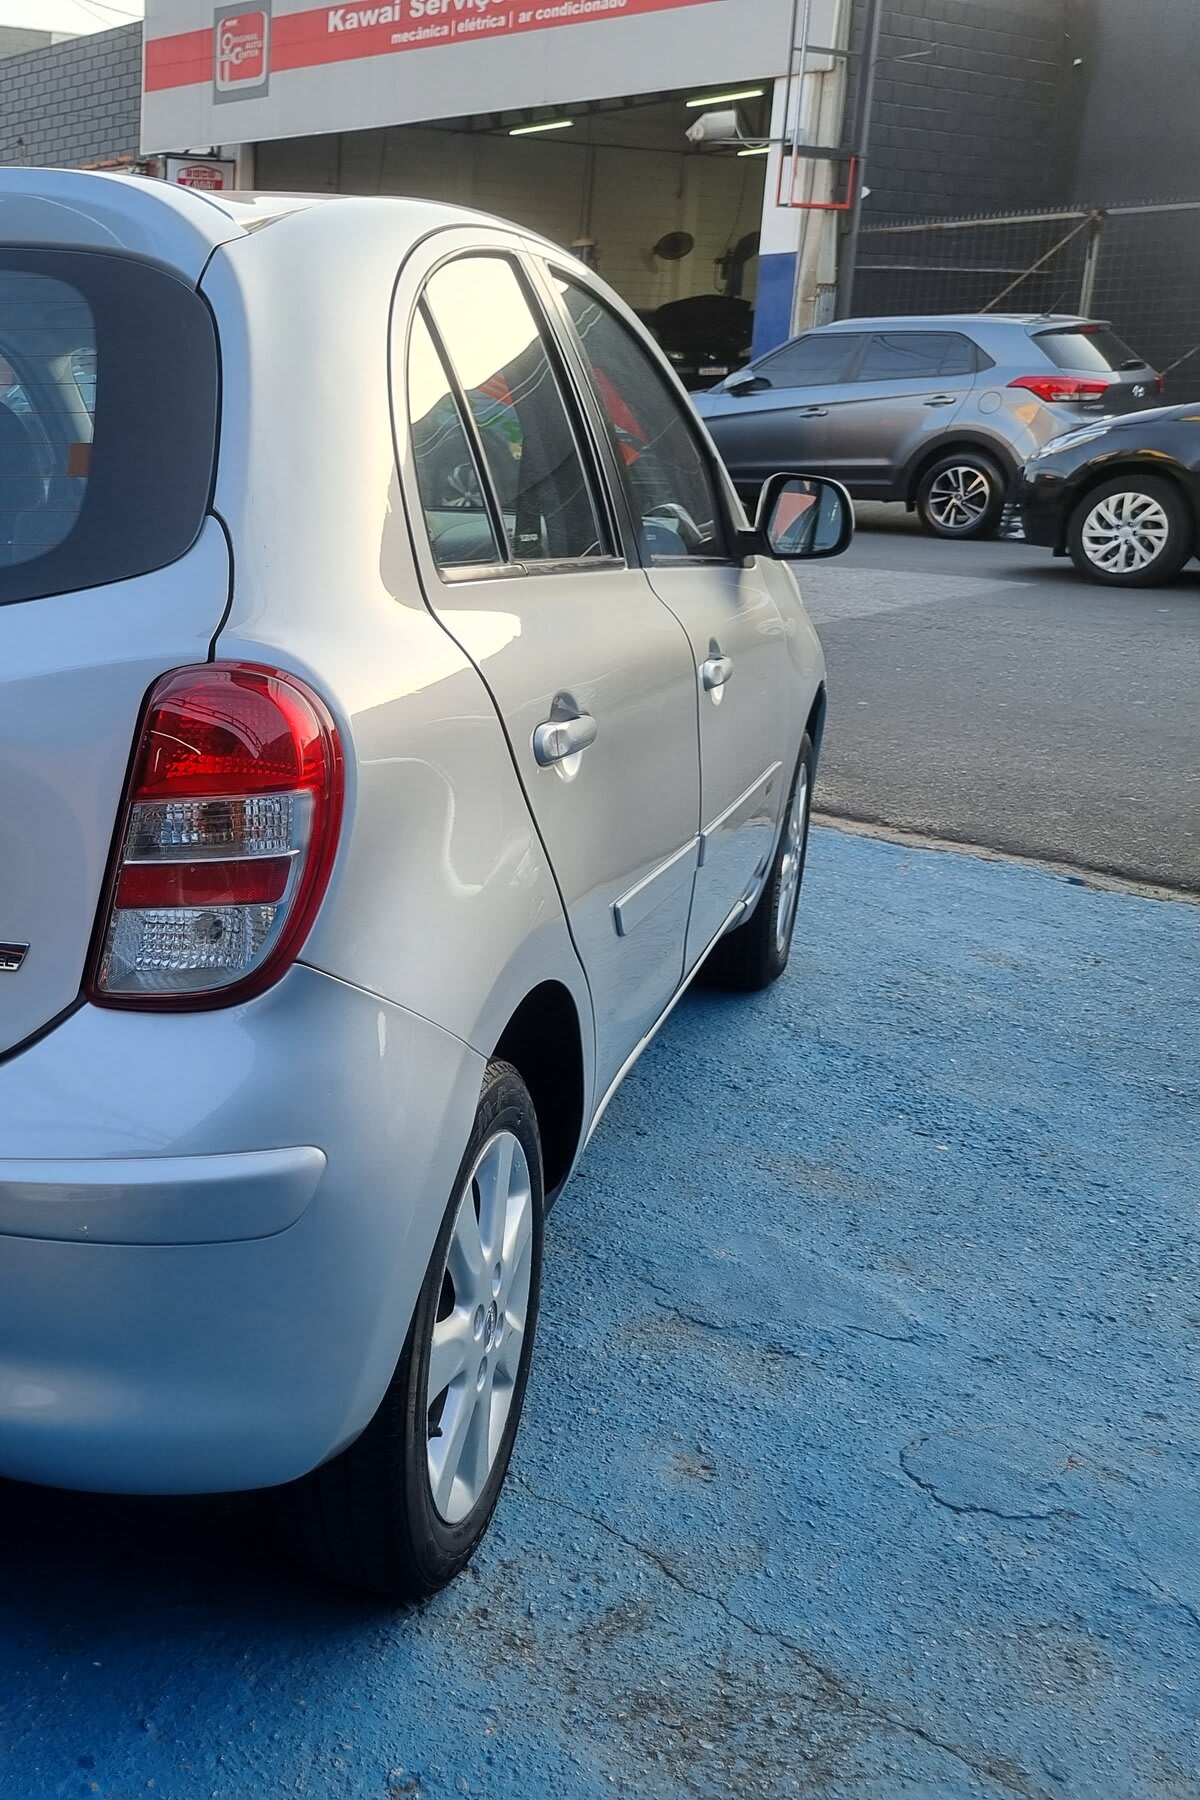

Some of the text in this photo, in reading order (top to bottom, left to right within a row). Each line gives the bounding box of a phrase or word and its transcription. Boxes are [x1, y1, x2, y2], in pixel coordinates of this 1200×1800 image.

[327, 1, 401, 33] Kawai
[456, 15, 506, 33] elétrica
[518, 11, 533, 23] ar
